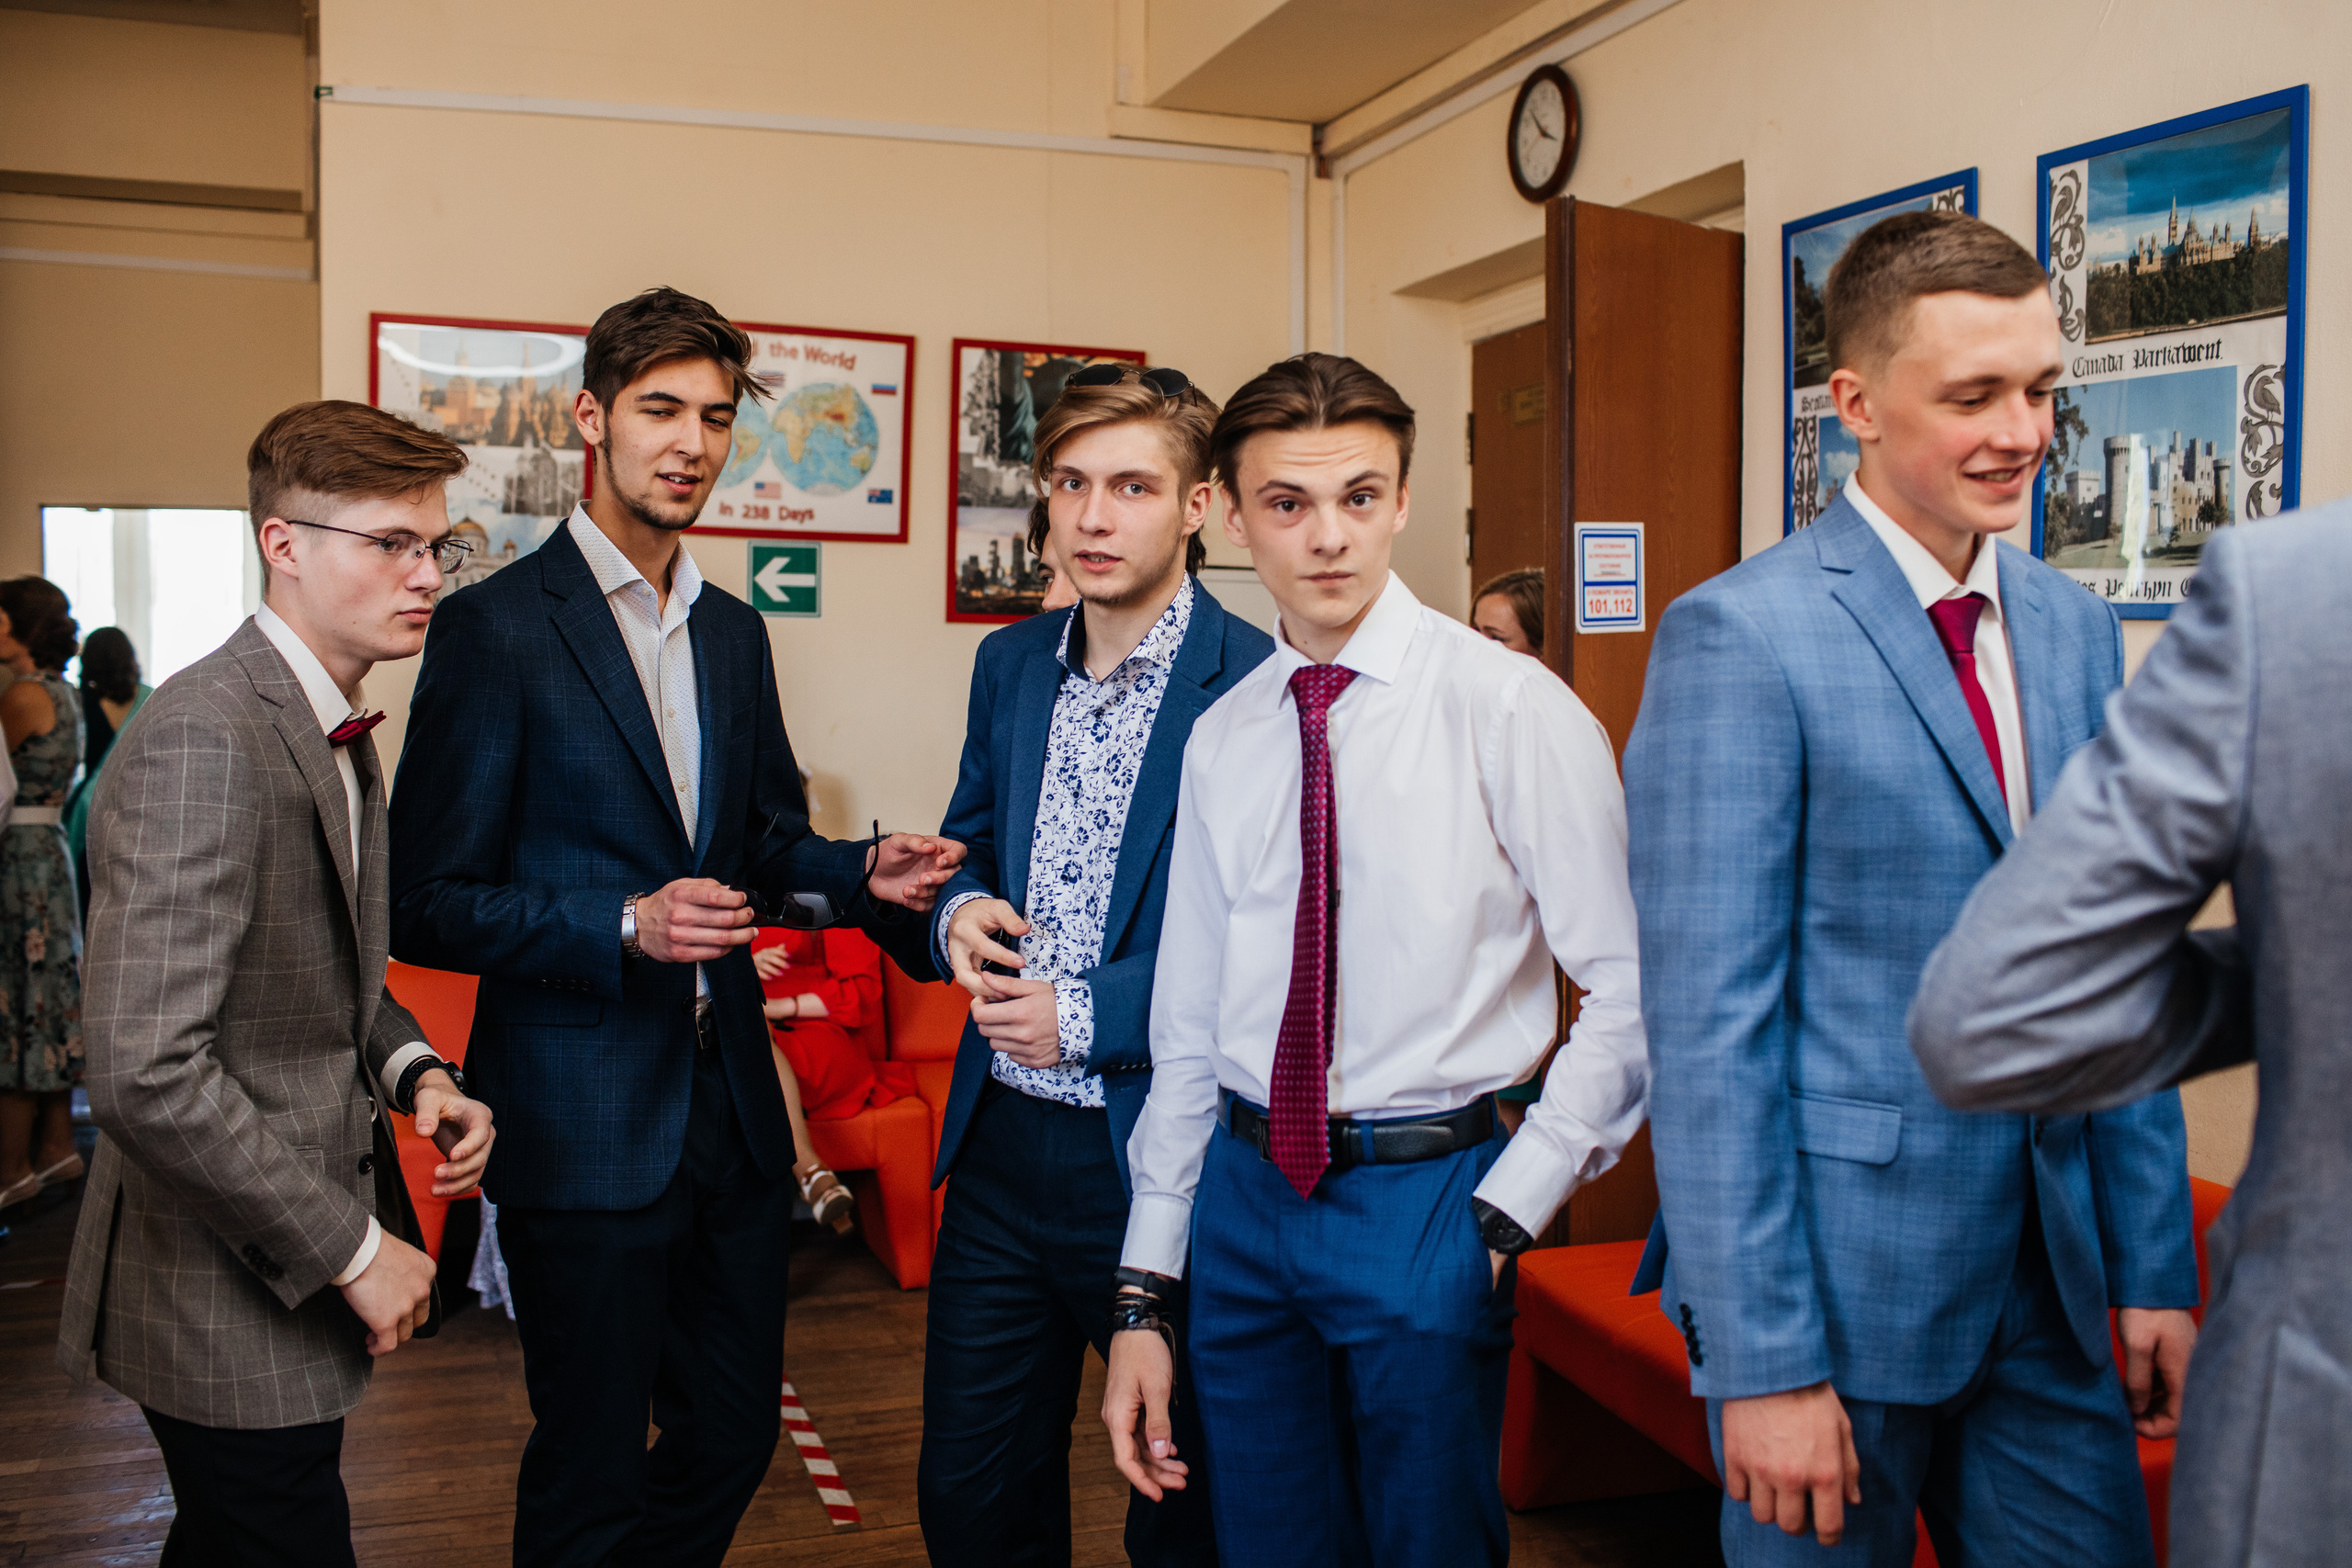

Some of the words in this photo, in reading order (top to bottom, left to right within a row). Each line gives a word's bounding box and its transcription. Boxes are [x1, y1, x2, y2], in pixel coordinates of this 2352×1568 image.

[769, 341, 798, 359] the
[804, 344, 856, 370] World
[2072, 354, 2124, 378] Canada
[741, 503, 771, 520] 238
[778, 506, 815, 525] Days
